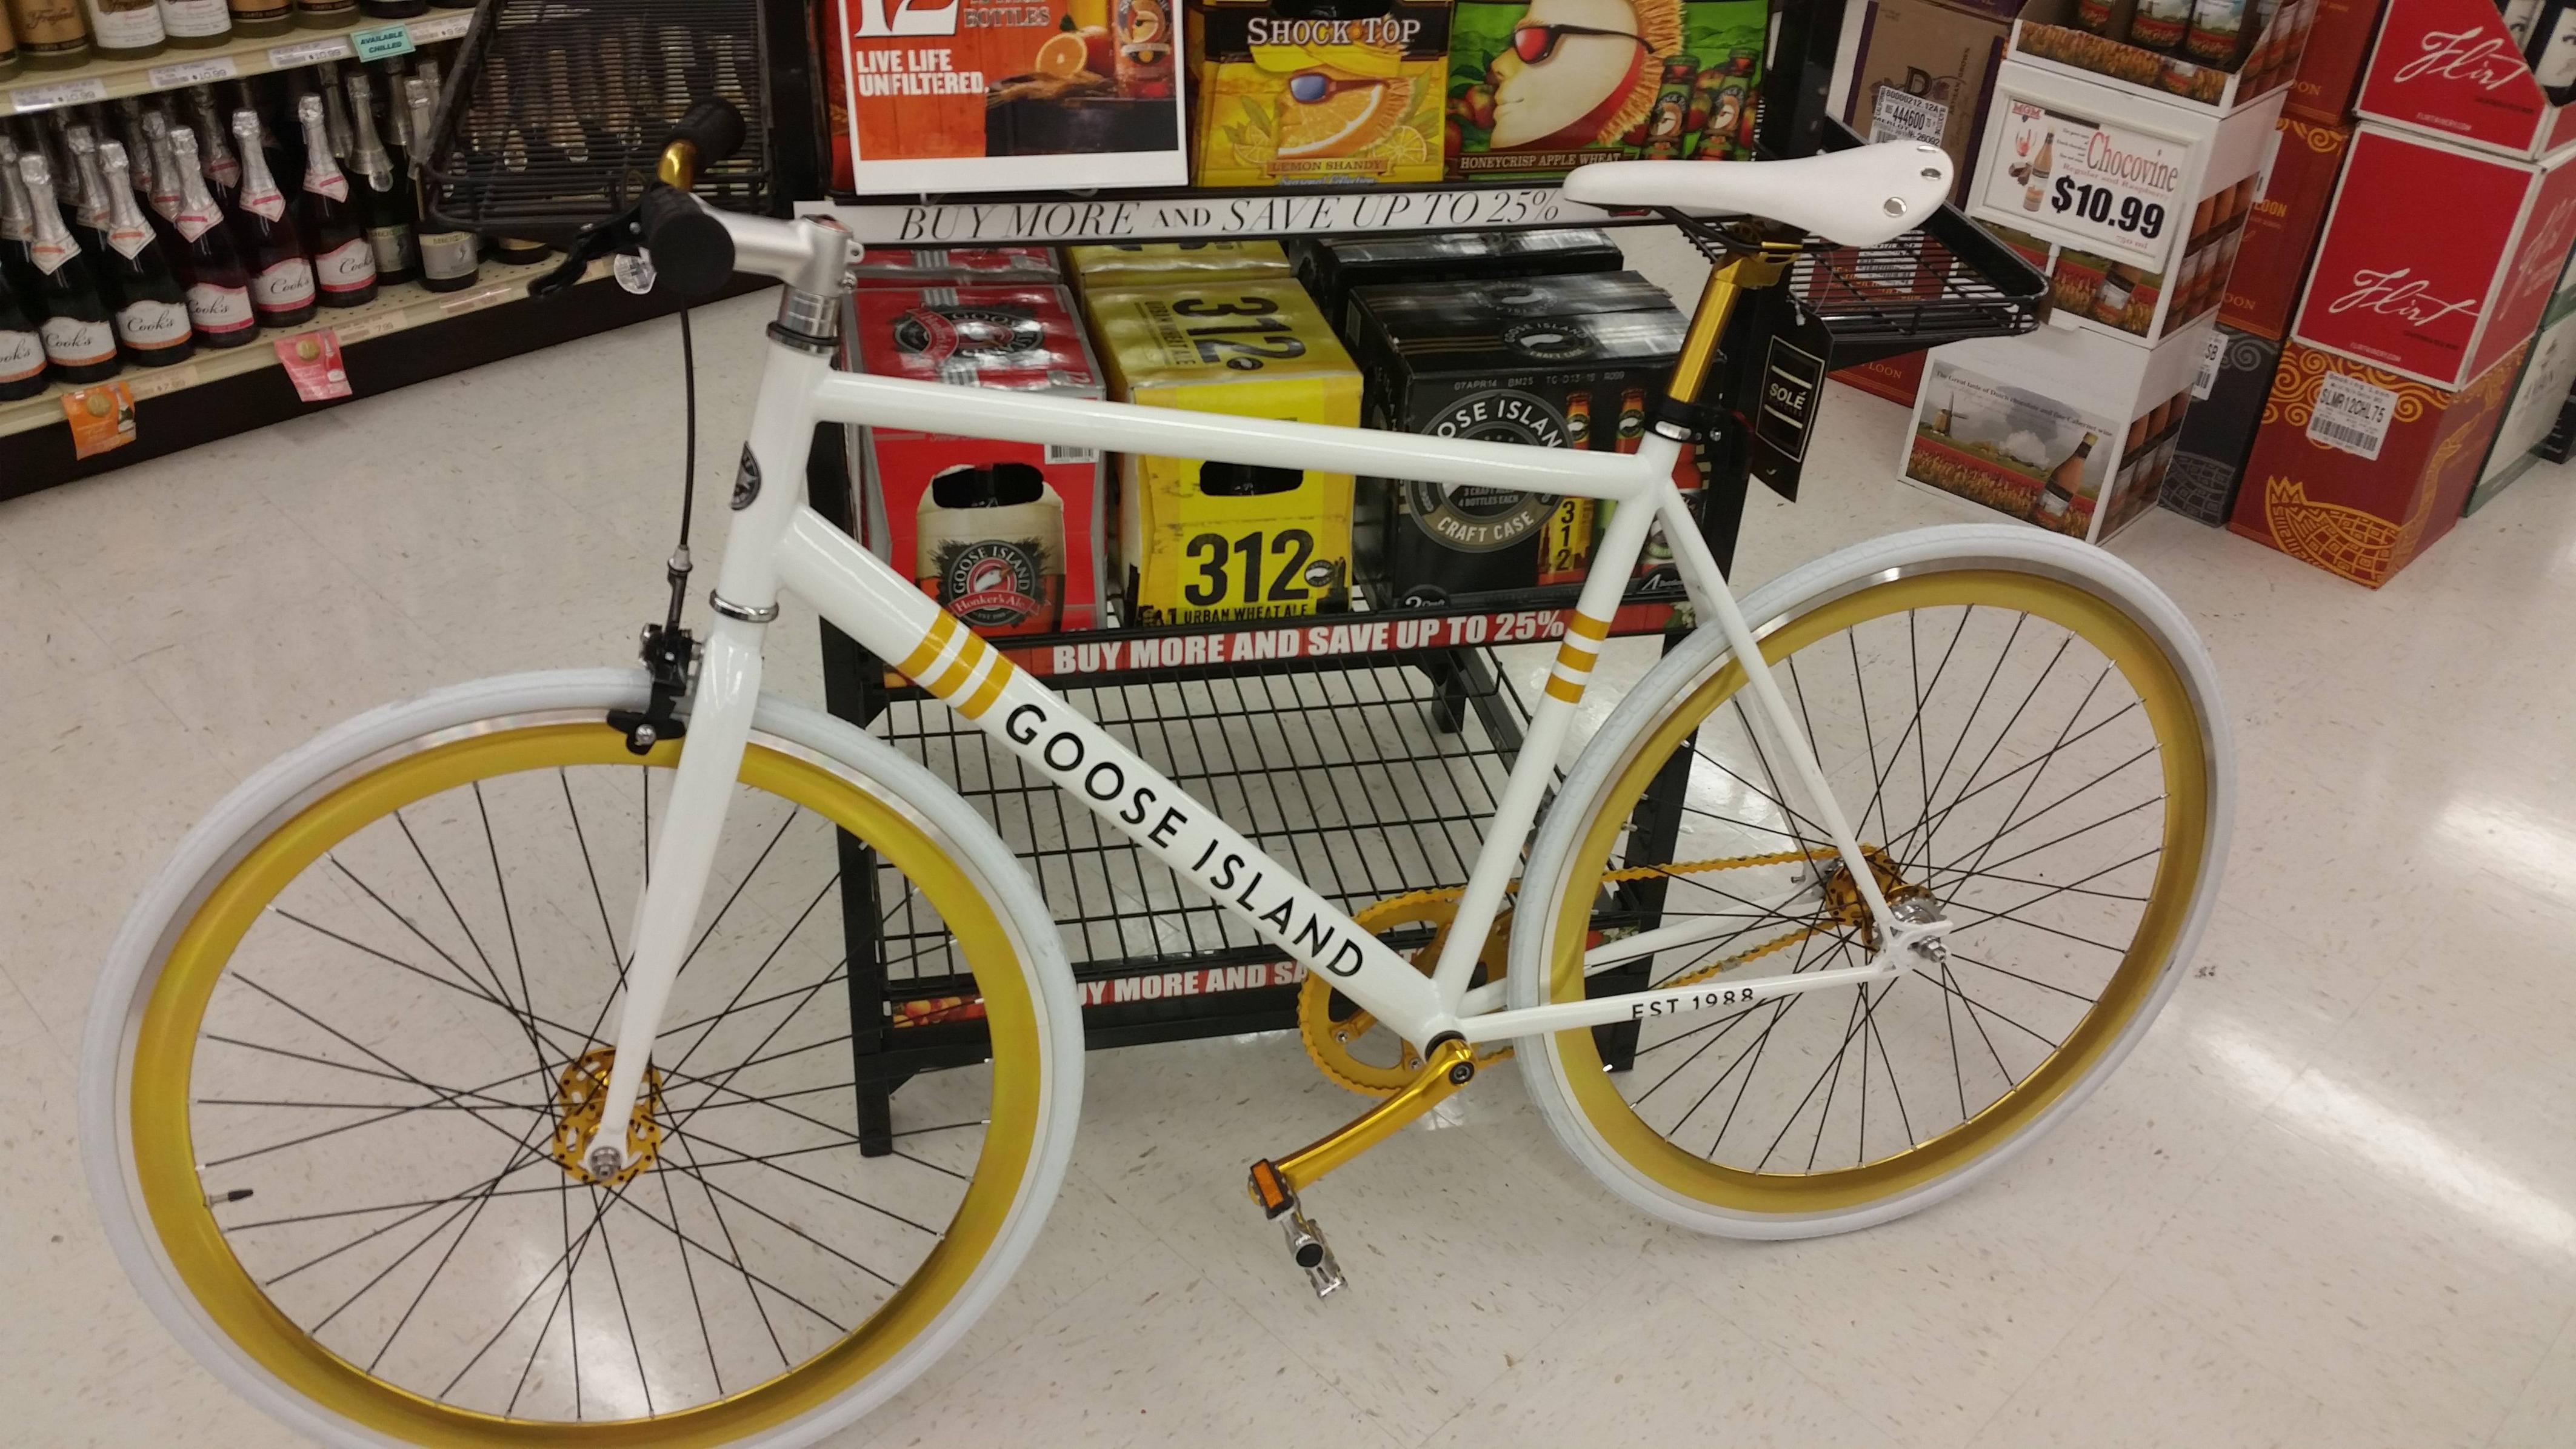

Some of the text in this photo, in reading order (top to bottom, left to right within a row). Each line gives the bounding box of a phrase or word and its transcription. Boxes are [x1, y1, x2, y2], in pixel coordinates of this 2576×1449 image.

[964, 7, 1050, 28] BOTTLES
[361, 31, 403, 45] AVAILABLE
[1247, 18, 1421, 45] SHOCK TOP
[369, 41, 402, 54] CHILLED
[856, 49, 953, 73] LIVE LIFE
[858, 72, 990, 97] UNFILTERED.
[1892, 105, 1926, 130] 444600
[1273, 159, 1384, 172] LEMON SHANDY
[1460, 154, 1537, 169] HONEYCRISP
[1540, 153, 1576, 167] APPLE
[2087, 132, 2178, 192] Chocovine
[897, 189, 1559, 240] BUY MORE AND SAVE UP TO 25%
[2051, 175, 2165, 239] $10.99
[270, 267, 310, 294] Cook's
[187, 295, 229, 315] Cook's
[2224, 293, 2256, 310] OON
[2329, 269, 2478, 326] Flirt
[127, 310, 175, 332] Cook's
[45, 327, 92, 347] Cook's
[1769, 383, 1806, 410] SOLÉ
[1498, 400, 1563, 447] ISLAN
[1438, 511, 1534, 543] CRAFT CASE
[953, 546, 1030, 594] GOOSE ISLAND
[1185, 529, 1315, 606] 312
[955, 594, 1005, 612] Honker's
[1184, 607, 1230, 624] URBAN
[1234, 606, 1280, 621] WHEAT
[1053, 609, 1565, 675] BUY MORE AND SAVE UP TO 25%
[1006, 703, 1364, 979] GOOSE ISLAND
[1114, 971, 1200, 1003] MORE
[1205, 963, 1266, 992] AND
[1274, 960, 1308, 985] SA
[1632, 988, 1753, 1019] EST 1988
